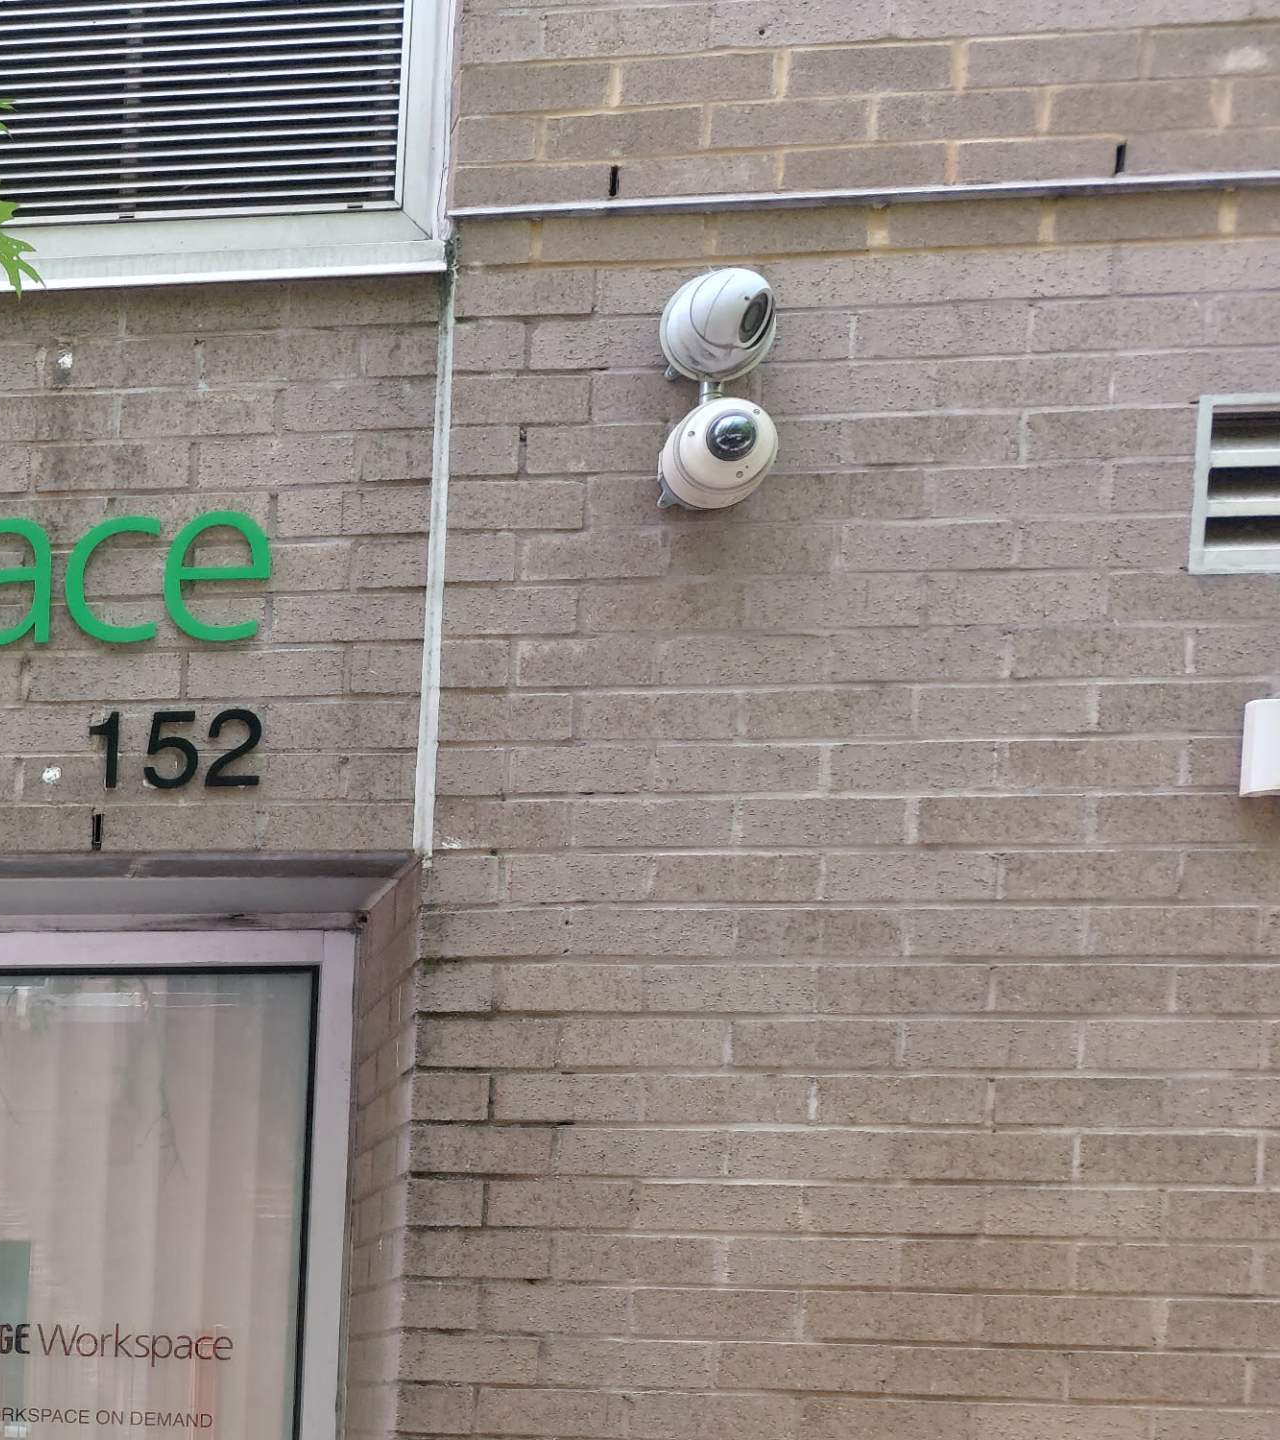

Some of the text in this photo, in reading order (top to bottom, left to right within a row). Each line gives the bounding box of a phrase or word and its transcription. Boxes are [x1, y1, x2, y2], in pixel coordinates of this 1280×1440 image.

[89, 709, 264, 790] 152
[39, 1323, 234, 1367] Workspace
[96, 1410, 124, 1426] ON
[130, 1411, 213, 1429] DEMAND
